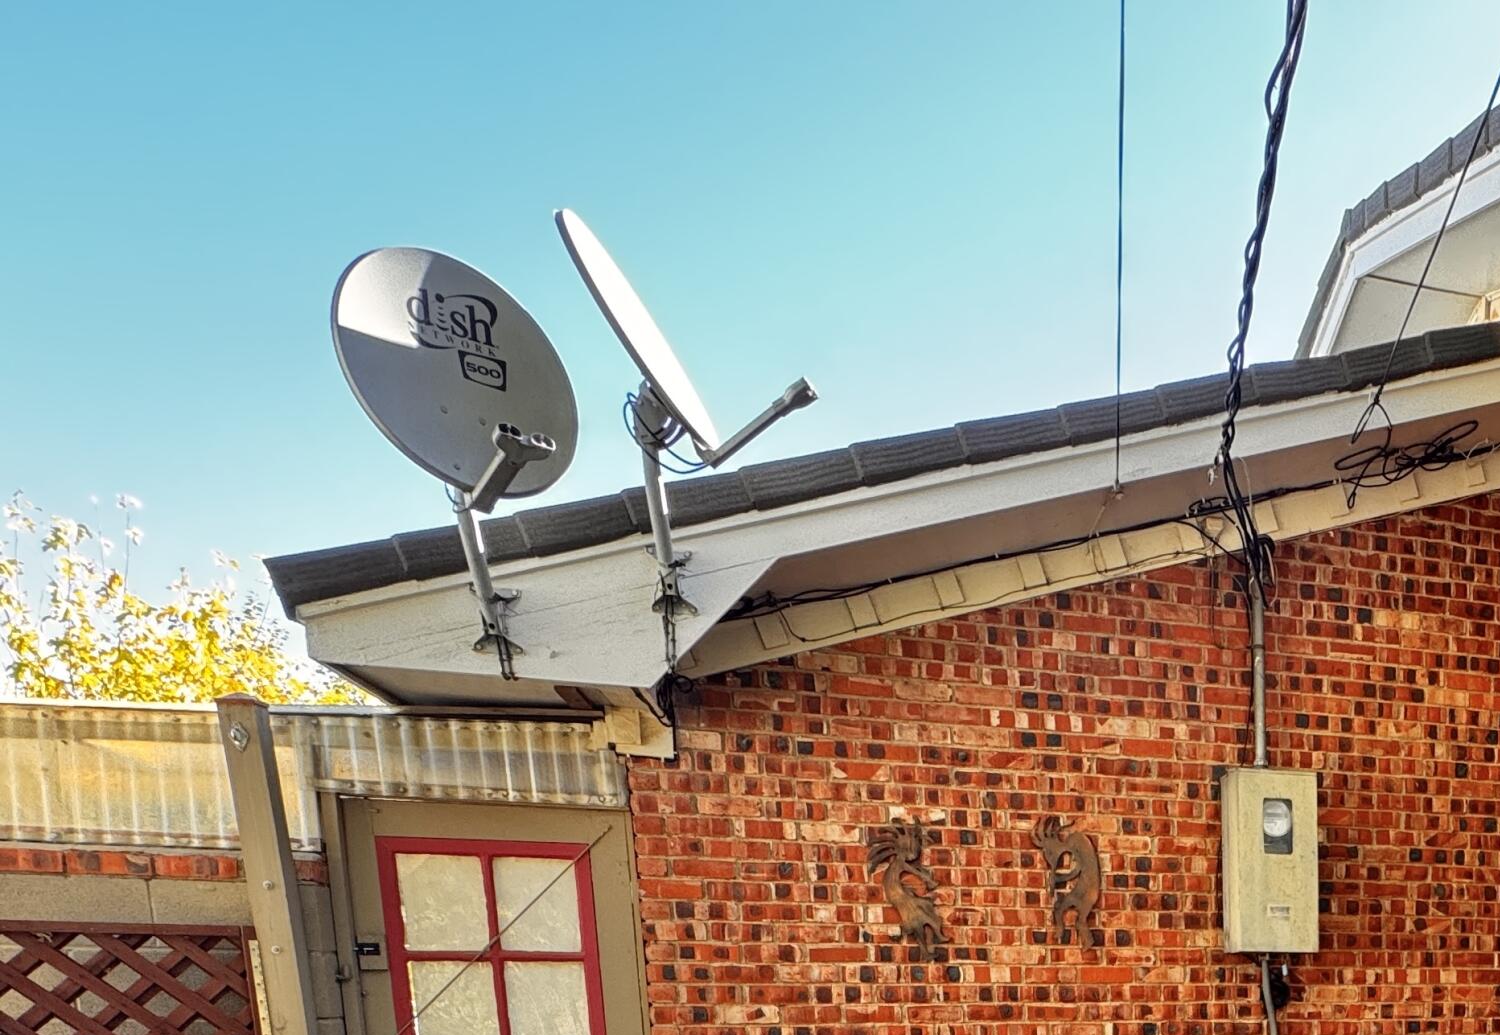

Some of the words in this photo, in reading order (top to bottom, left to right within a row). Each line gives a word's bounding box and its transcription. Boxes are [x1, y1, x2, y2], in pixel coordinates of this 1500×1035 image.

[406, 288, 497, 347] dish
[407, 320, 497, 357] NETWORK
[466, 361, 501, 379] 500
